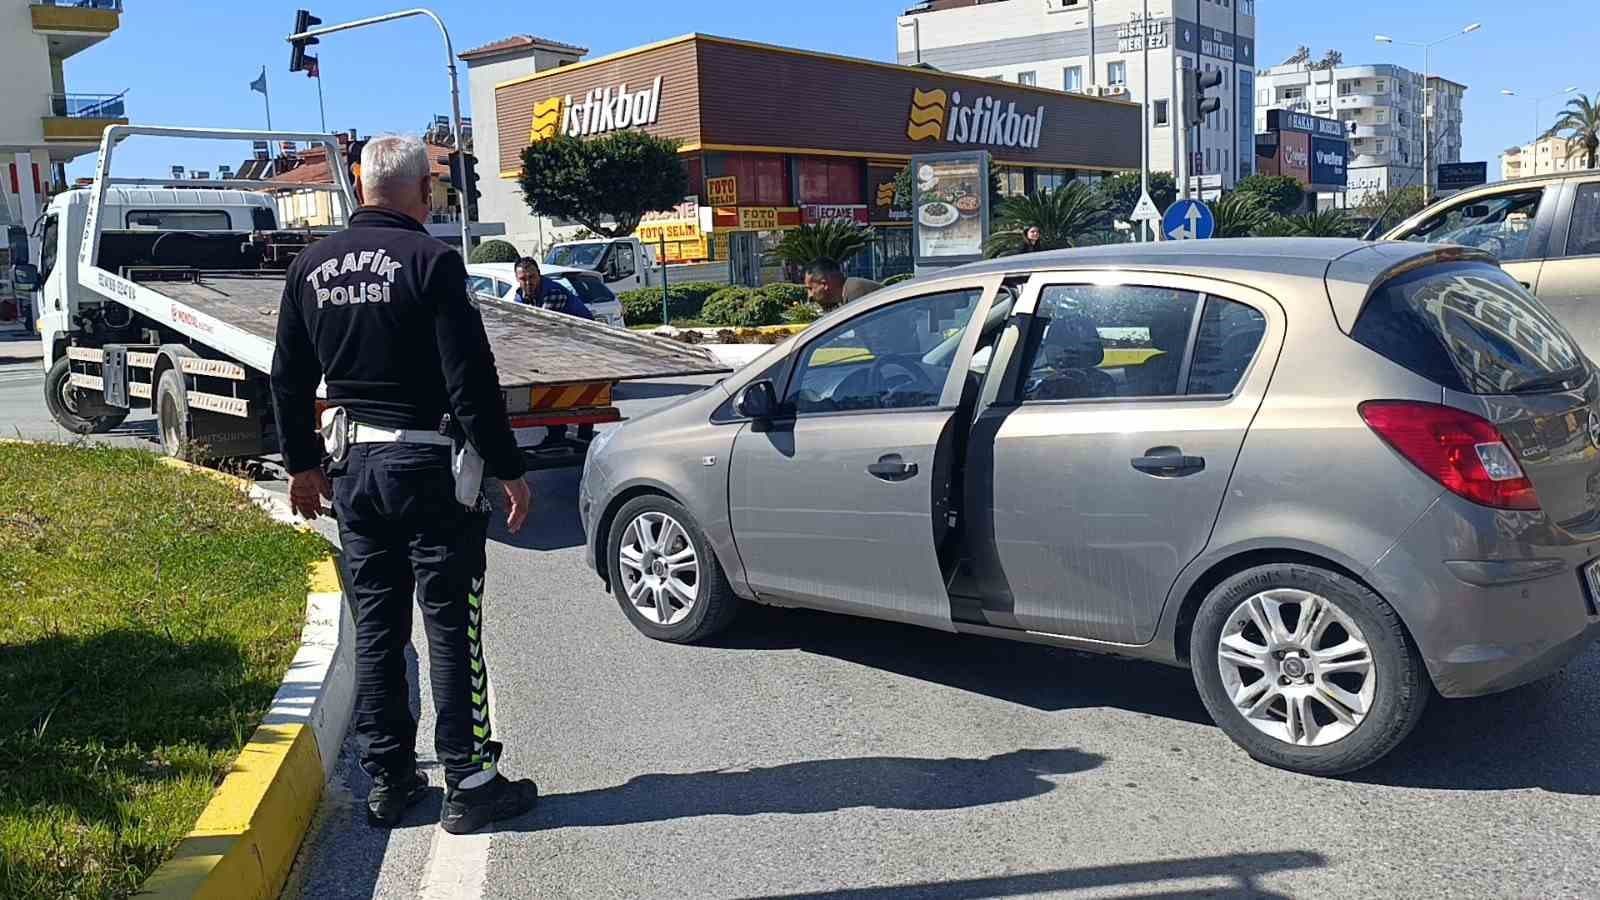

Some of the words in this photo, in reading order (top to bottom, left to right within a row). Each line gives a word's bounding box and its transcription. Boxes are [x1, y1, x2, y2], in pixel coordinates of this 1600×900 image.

[561, 75, 662, 137] istikbal
[946, 91, 1044, 148] istikbal
[709, 179, 735, 195] FOTO
[743, 209, 775, 218] FOTO
[306, 249, 402, 290] TRAFİK
[316, 281, 391, 309] POLİSİ
